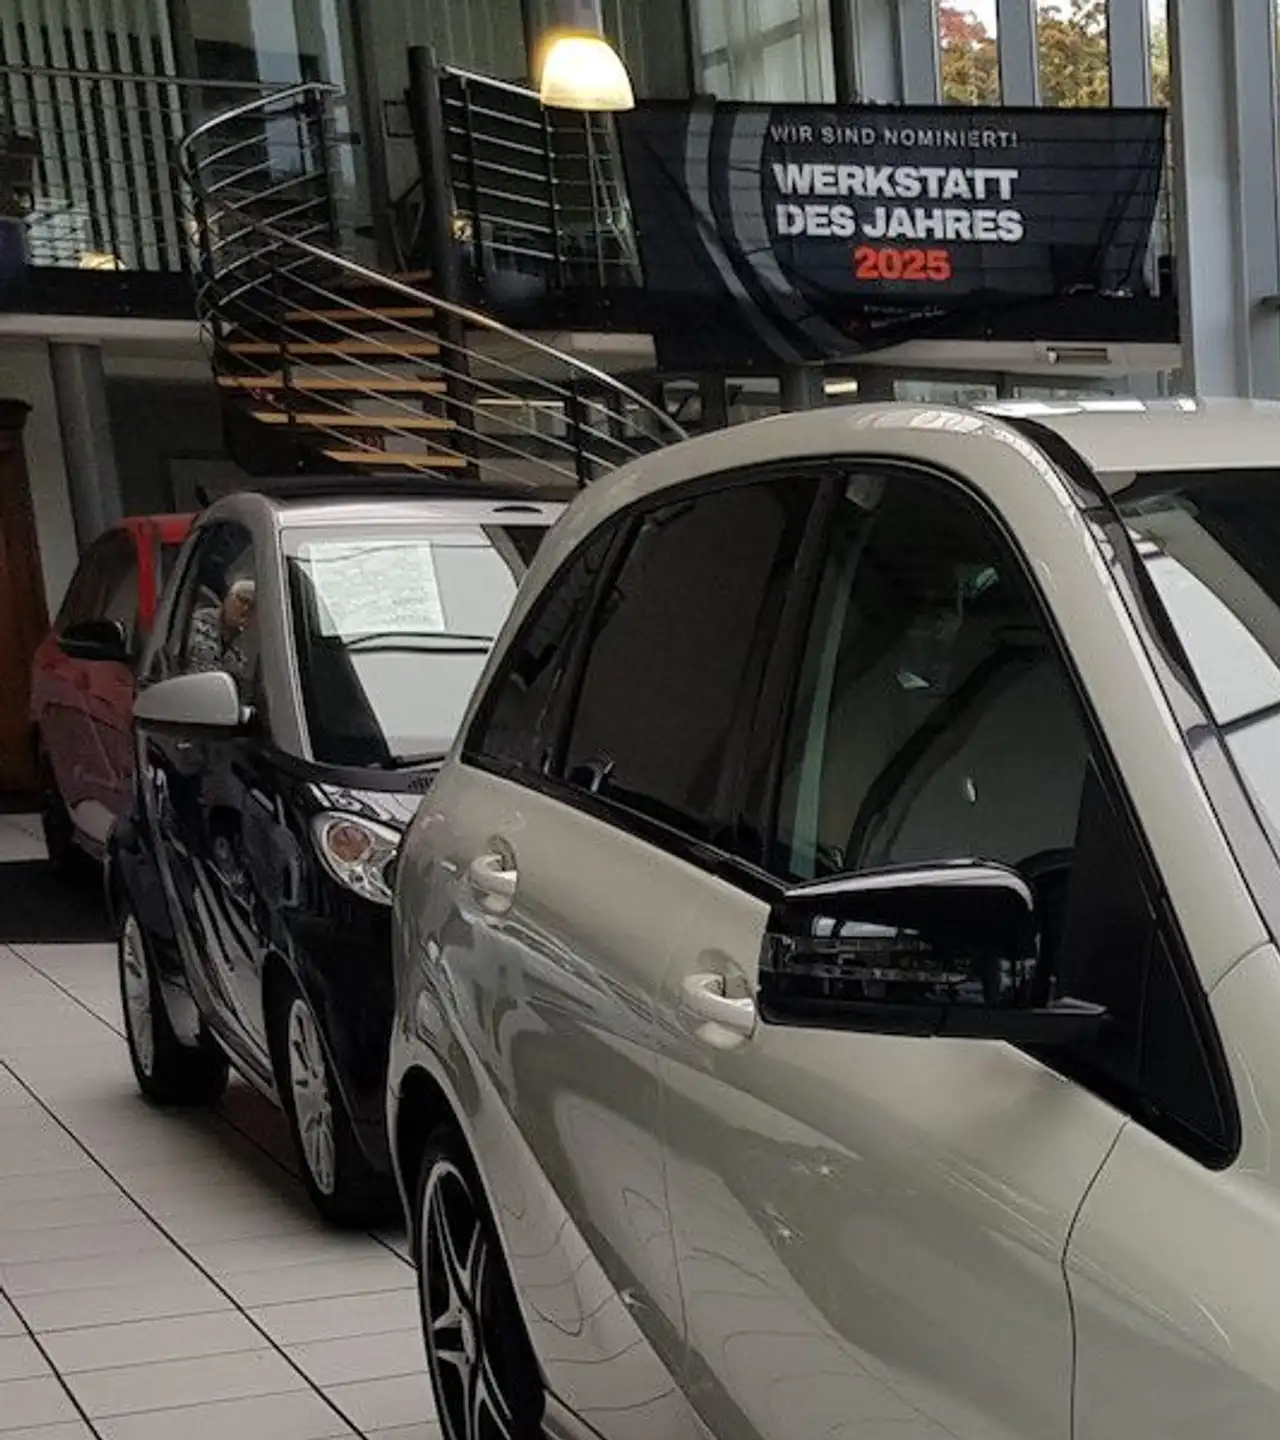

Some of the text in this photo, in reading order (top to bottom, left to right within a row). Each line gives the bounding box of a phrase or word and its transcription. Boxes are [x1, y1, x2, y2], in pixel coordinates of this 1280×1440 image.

[770, 124, 1018, 149] WIR SIND NOMINIERT!
[772, 163, 1019, 200] WERKSTATT
[776, 203, 1025, 242] DES JAHRES
[854, 247, 952, 280] 2025
